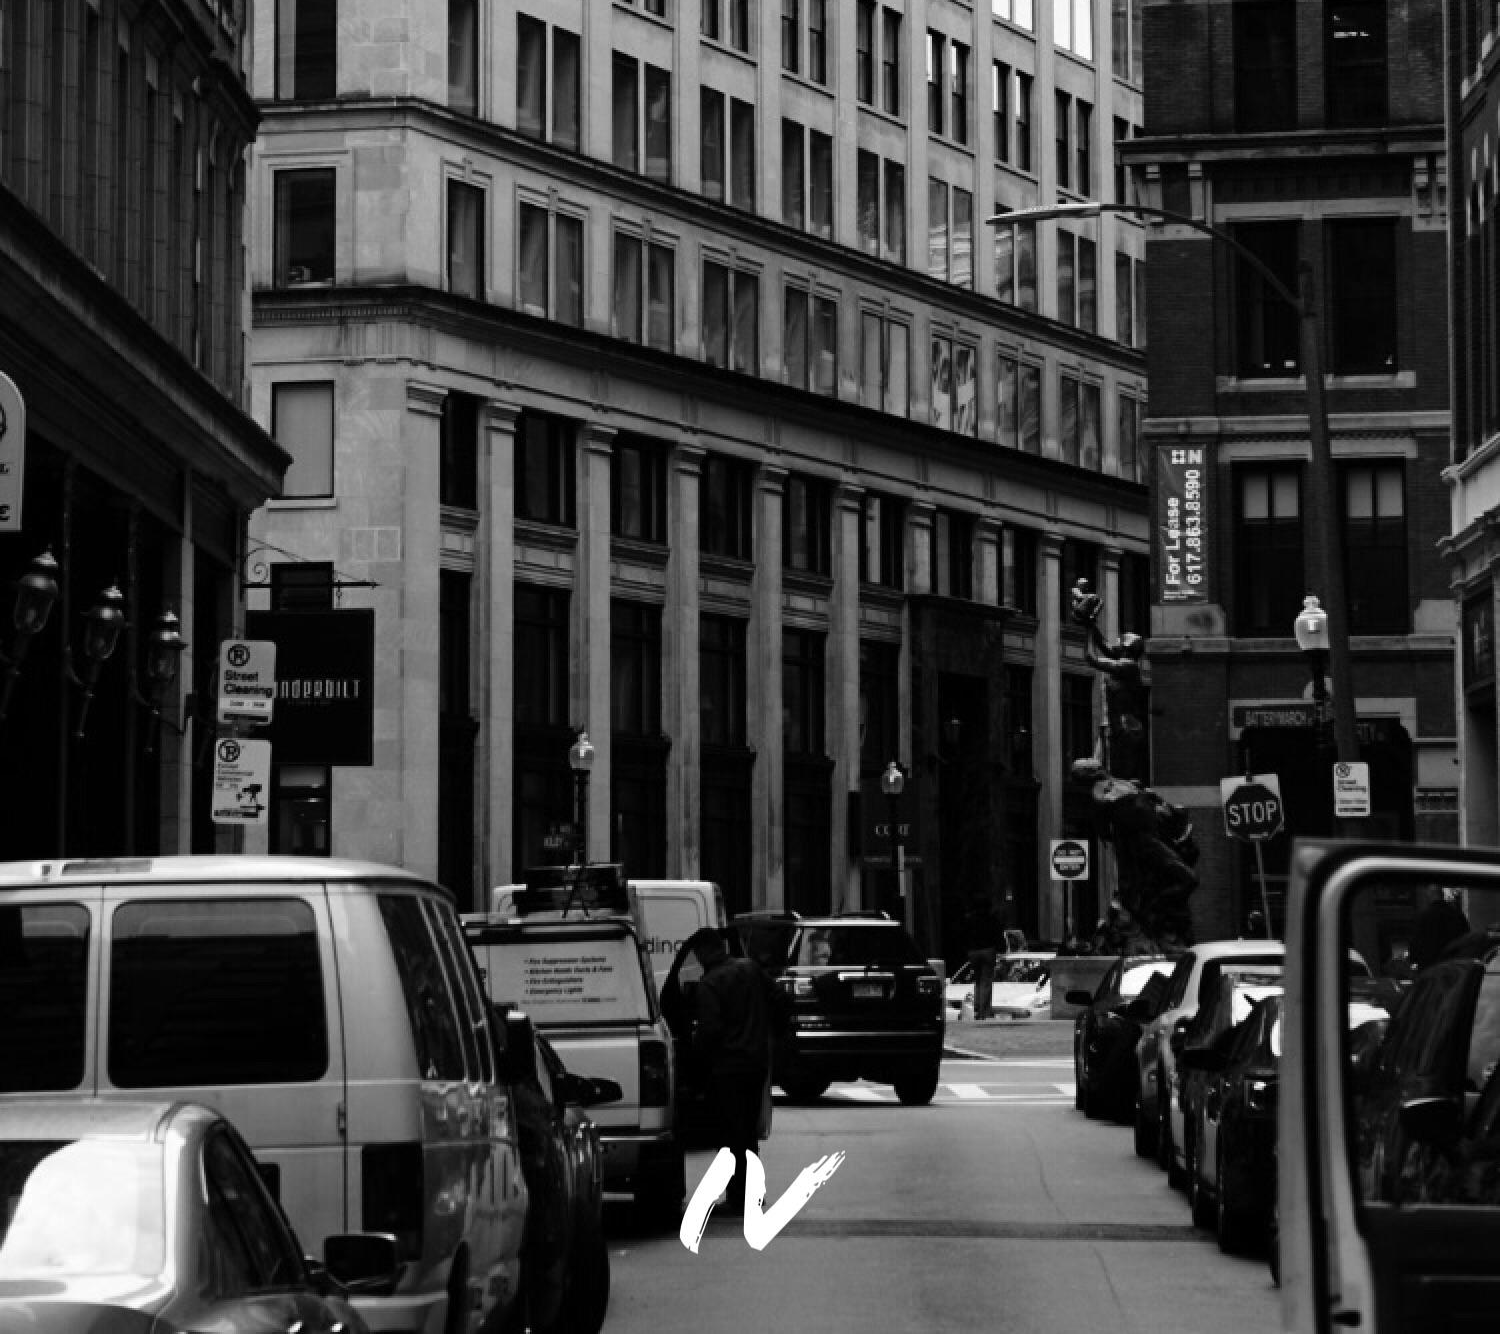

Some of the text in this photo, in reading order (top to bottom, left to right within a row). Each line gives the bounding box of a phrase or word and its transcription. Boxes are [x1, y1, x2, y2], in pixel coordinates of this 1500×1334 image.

[1165, 497, 1181, 551] Lease
[1185, 469, 1201, 585] 617.863.8590
[1165, 555, 1181, 585] For
[224, 670, 259, 682] Street
[224, 683, 273, 698] Cleaning
[1229, 801, 1277, 826] STOP
